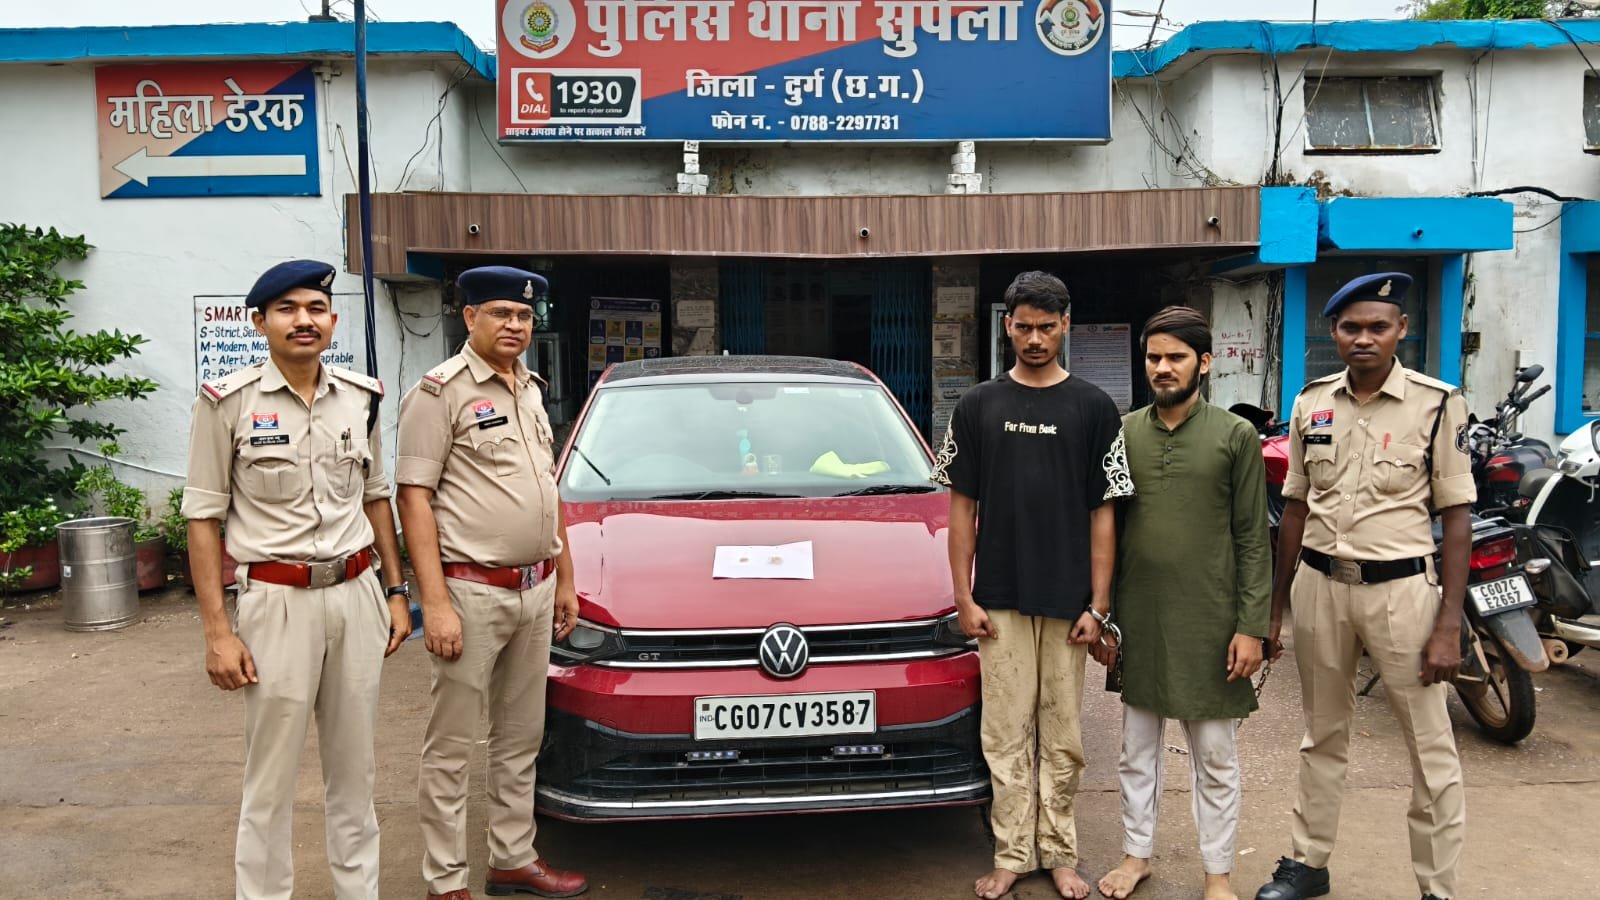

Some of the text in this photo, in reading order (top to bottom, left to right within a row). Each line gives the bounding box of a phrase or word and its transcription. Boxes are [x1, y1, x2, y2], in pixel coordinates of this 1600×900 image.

[748, 0, 860, 41] थाना
[556, 80, 622, 105] 1930
[686, 69, 757, 98] जिला
[784, 68, 825, 106] दुर्ग
[832, 68, 924, 104] (छ.ग.)
[107, 79, 214, 139] महिला
[520, 104, 549, 114] DIAL
[587, 107, 604, 115] cyber
[558, 125, 572, 136] होने
[574, 127, 584, 136] पर
[711, 111, 747, 130] फोन
[790, 115, 899, 131] 0788-2297731
[204, 306, 249, 322] SMART
[320, 352, 353, 365] aptable
[1004, 421, 1057, 434] Far From Basic
[1480, 578, 1518, 598] CG07C
[1485, 590, 1521, 609] E2657
[638, 652, 660, 661] GT
[714, 699, 871, 731] CG07CV3587
